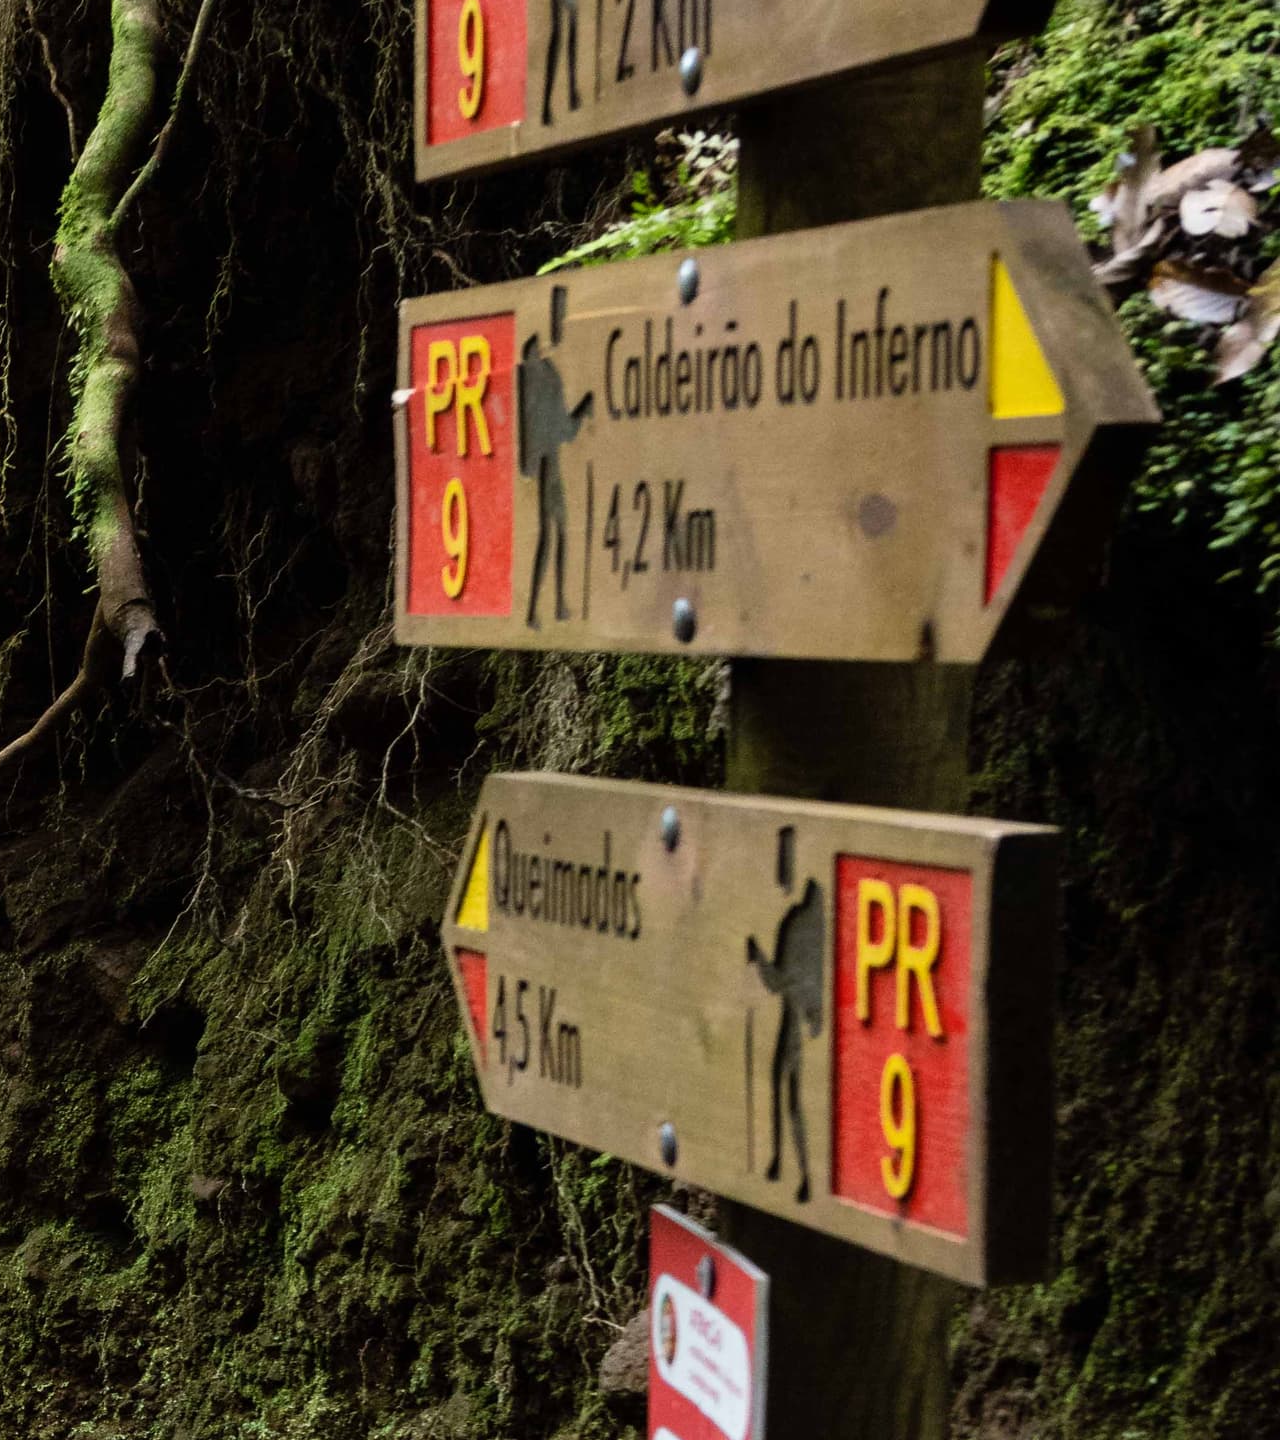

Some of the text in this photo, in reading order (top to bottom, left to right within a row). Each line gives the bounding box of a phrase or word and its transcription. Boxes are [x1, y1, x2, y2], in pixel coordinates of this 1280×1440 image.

[426, 335, 493, 457] PR
[604, 287, 980, 421] Caldeirão do Inferno
[441, 477, 468, 600] 9
[603, 479, 717, 590] 4,2 Km
[493, 818, 641, 941] Queimados
[856, 879, 942, 1038] PR
[493, 975, 583, 1089] 4,5 Km
[880, 1053, 915, 1199] 9
